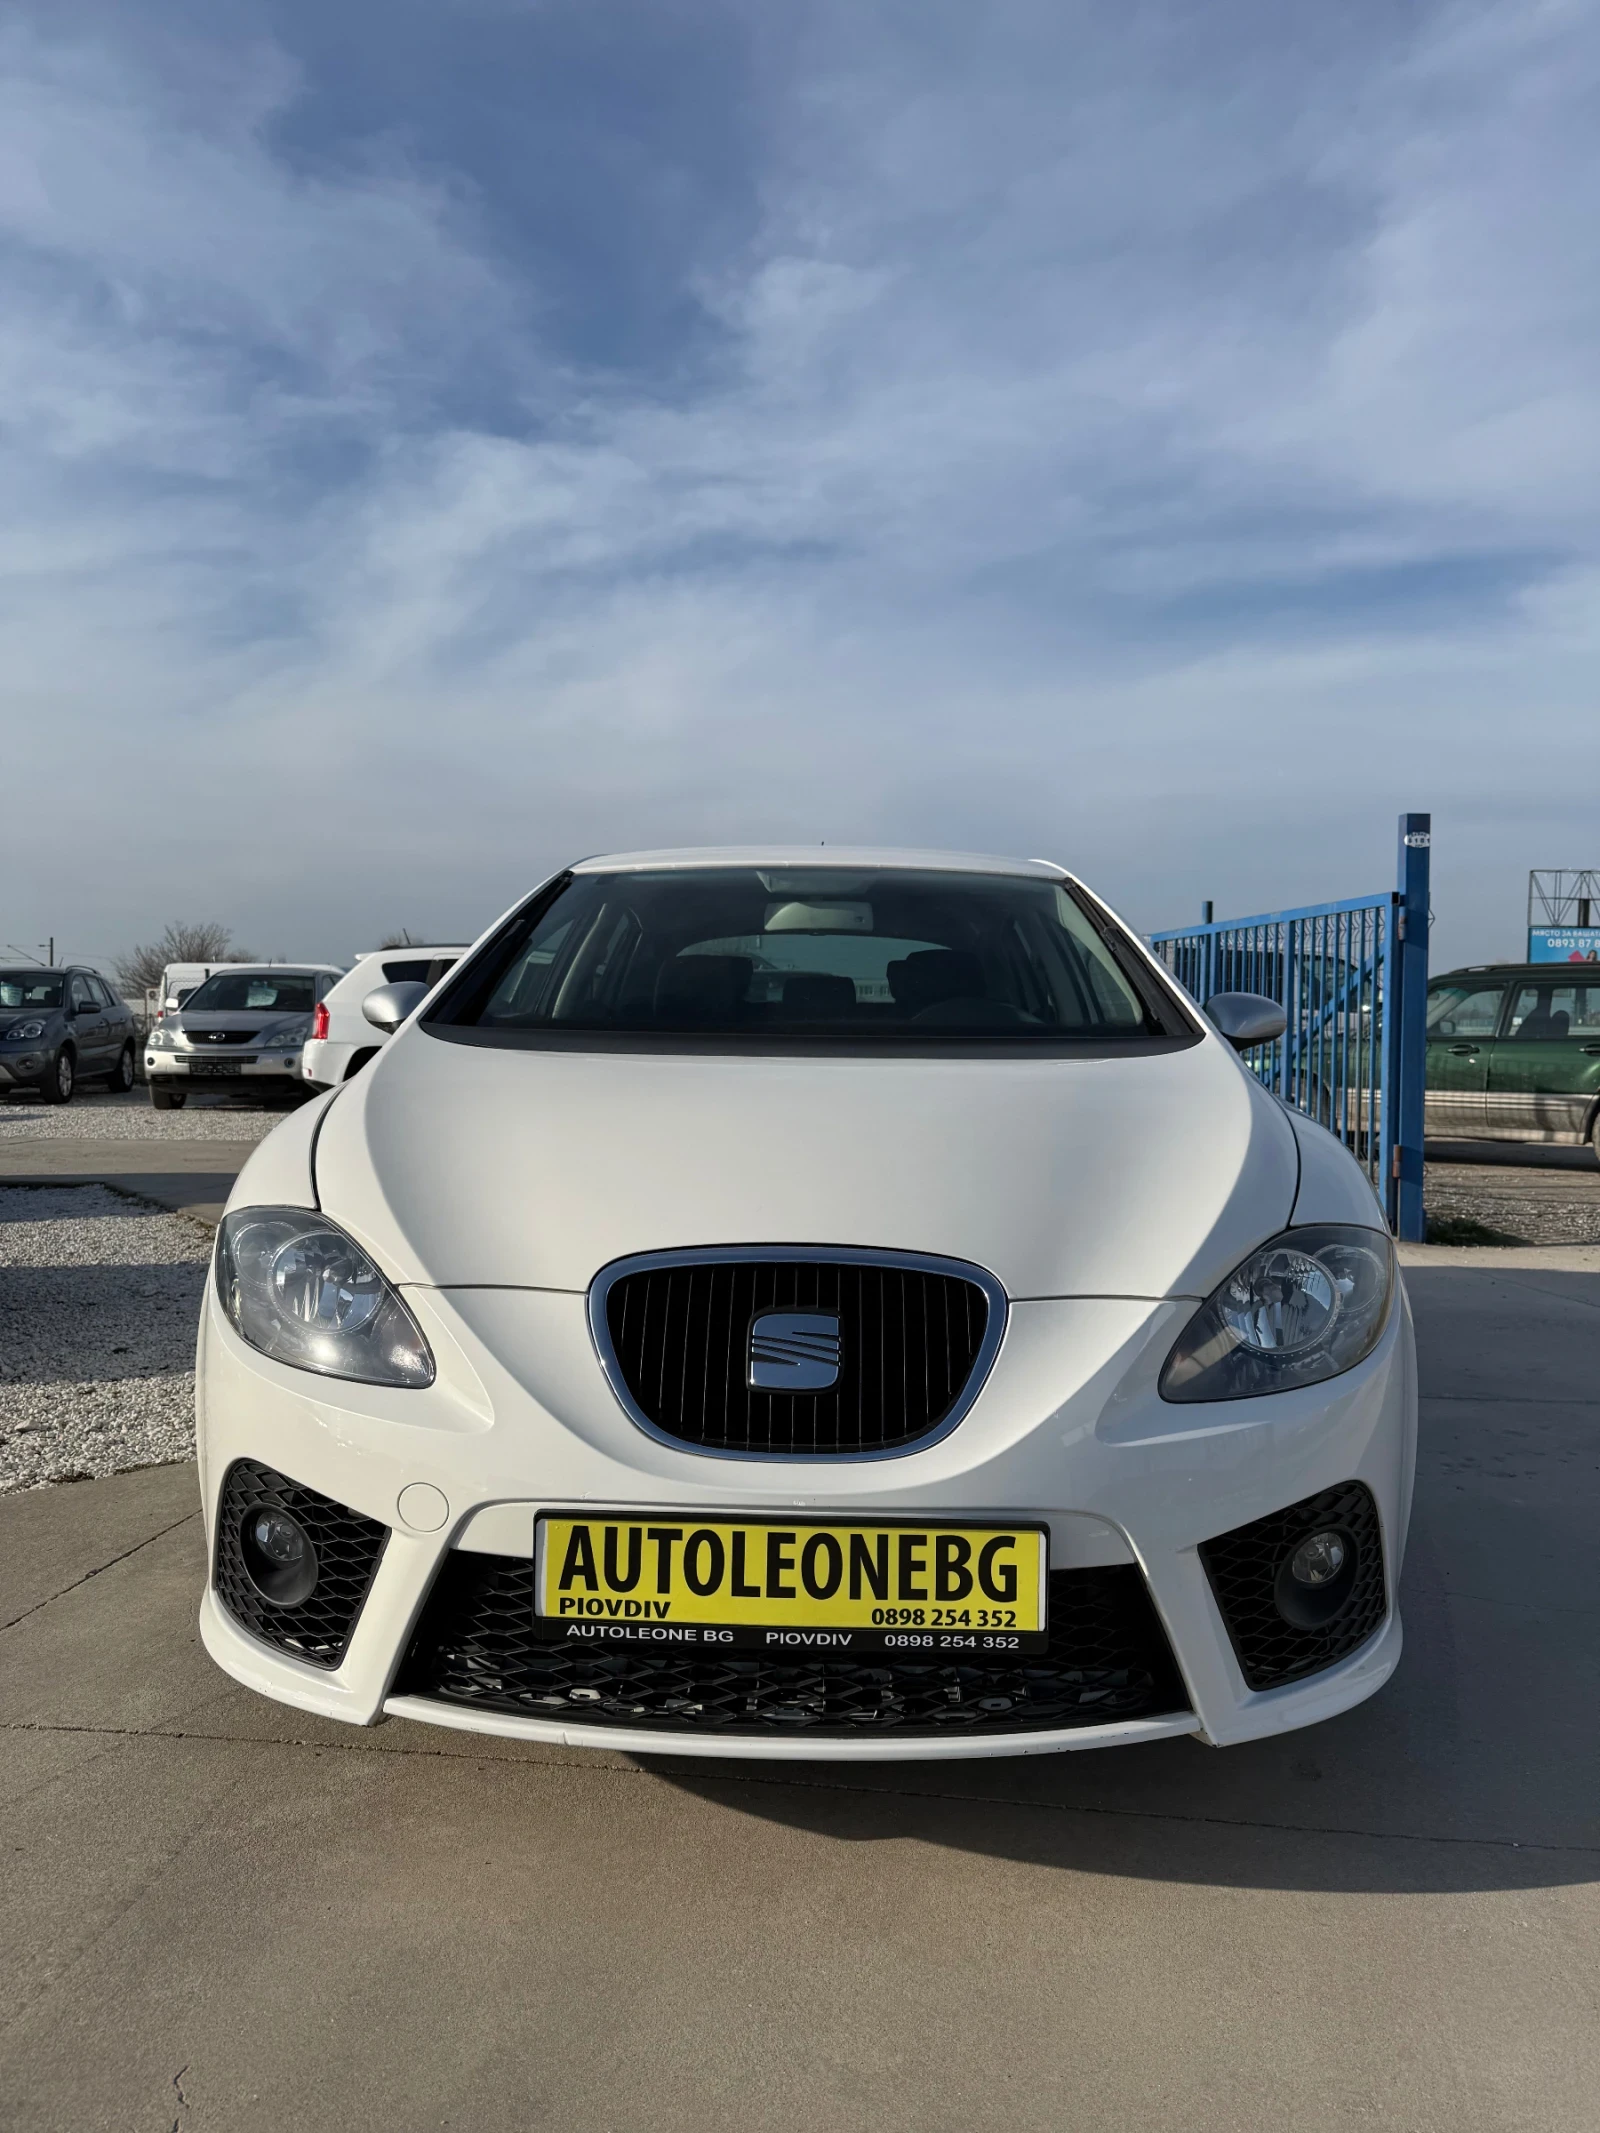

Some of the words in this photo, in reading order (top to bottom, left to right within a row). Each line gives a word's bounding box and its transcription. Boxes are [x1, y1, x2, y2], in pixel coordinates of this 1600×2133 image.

[1532, 929, 1561, 937] МЯСТО
[1547, 938, 1575, 948] 0893
[1578, 938, 1591, 948] 87
[558, 1524, 1018, 1603] AUTOLEONEBG
[559, 1597, 671, 1619] PIOVDIV
[871, 1608, 926, 1626] 0898
[931, 1608, 971, 1627] 254
[976, 1610, 1017, 1628] 352
[566, 1624, 698, 1641] AUTOLEONE
[703, 1630, 734, 1643] BG
[765, 1632, 853, 1646] PIOVDIV
[884, 1634, 934, 1647] 0898
[939, 1635, 977, 1648] 254
[982, 1636, 1020, 1649] 352
